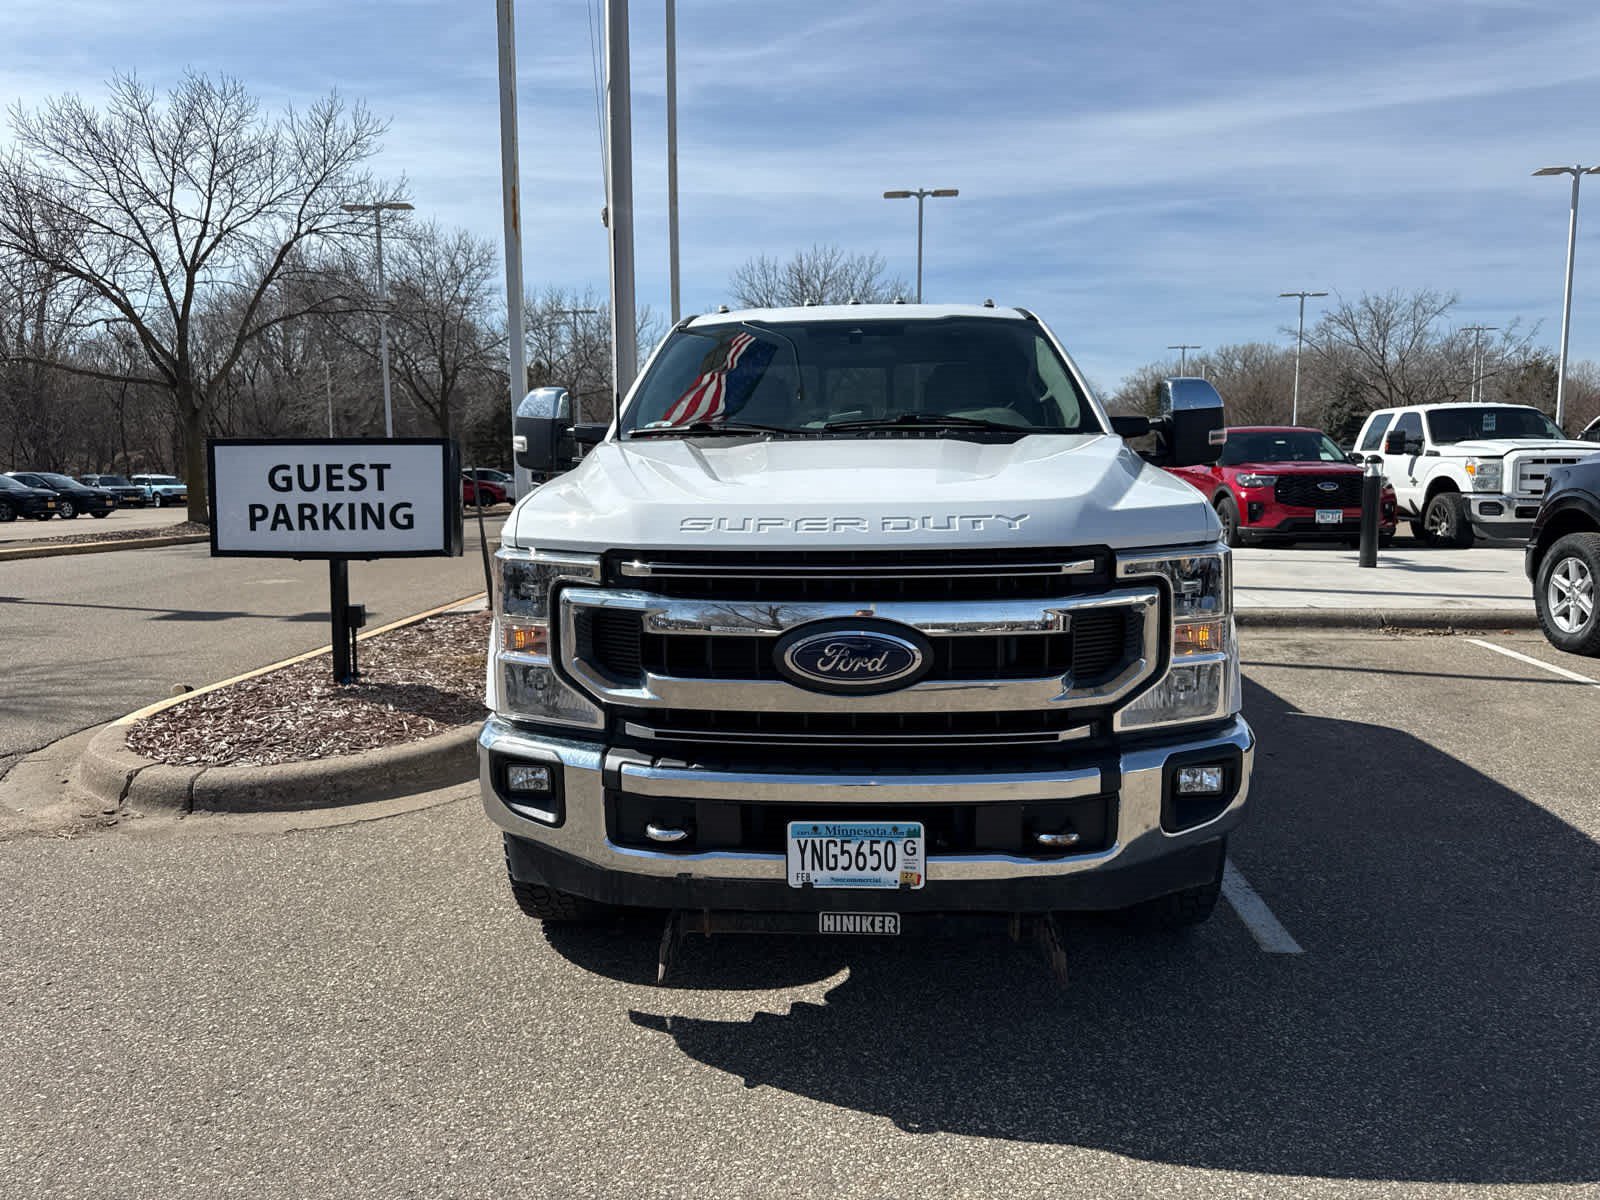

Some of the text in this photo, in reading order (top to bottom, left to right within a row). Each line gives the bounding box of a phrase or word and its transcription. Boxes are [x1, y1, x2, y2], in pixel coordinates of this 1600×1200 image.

[268, 464, 391, 492] GUEST
[248, 502, 415, 531] PARKING
[680, 514, 1030, 533] SUPER DUTY
[816, 642, 888, 672] Ford
[825, 825, 887, 836] Minnesota
[797, 839, 896, 872] YNG5650
[903, 839, 917, 856] G
[823, 914, 896, 933] HINIKER
